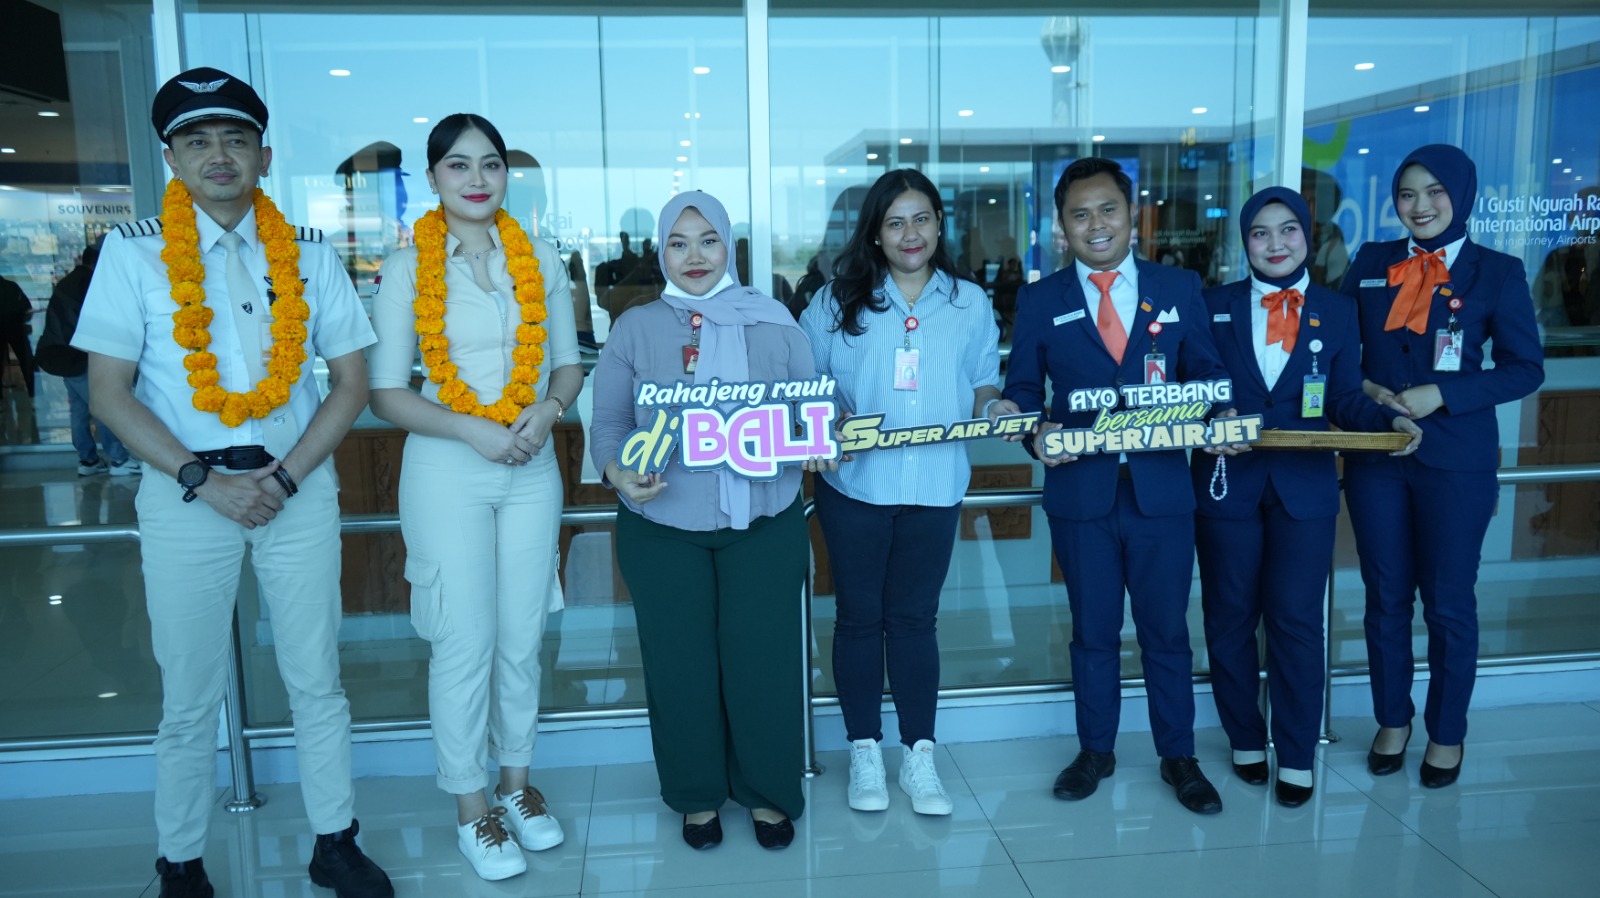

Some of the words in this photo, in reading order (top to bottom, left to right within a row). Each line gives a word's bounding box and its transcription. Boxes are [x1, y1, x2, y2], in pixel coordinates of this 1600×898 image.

[58, 204, 132, 215] SOUVENIRS
[1479, 196, 1484, 213] I
[1487, 195, 1525, 213] Gusti
[1529, 193, 1583, 217] Ngurah
[1470, 213, 1567, 233] International
[1556, 234, 1597, 247] Airports
[637, 379, 766, 405] Rahajeng
[772, 375, 835, 397] rauh
[1070, 388, 1117, 410] AYO
[1123, 381, 1231, 407] TERBANG
[947, 422, 990, 440] AIR
[993, 416, 1039, 435] JET
[1094, 401, 1208, 433] bersama
[621, 409, 679, 476] di
[685, 404, 833, 474] BALI
[1045, 426, 1144, 455] SUPER
[1150, 423, 1206, 449] AIR
[1210, 417, 1262, 445] JET
